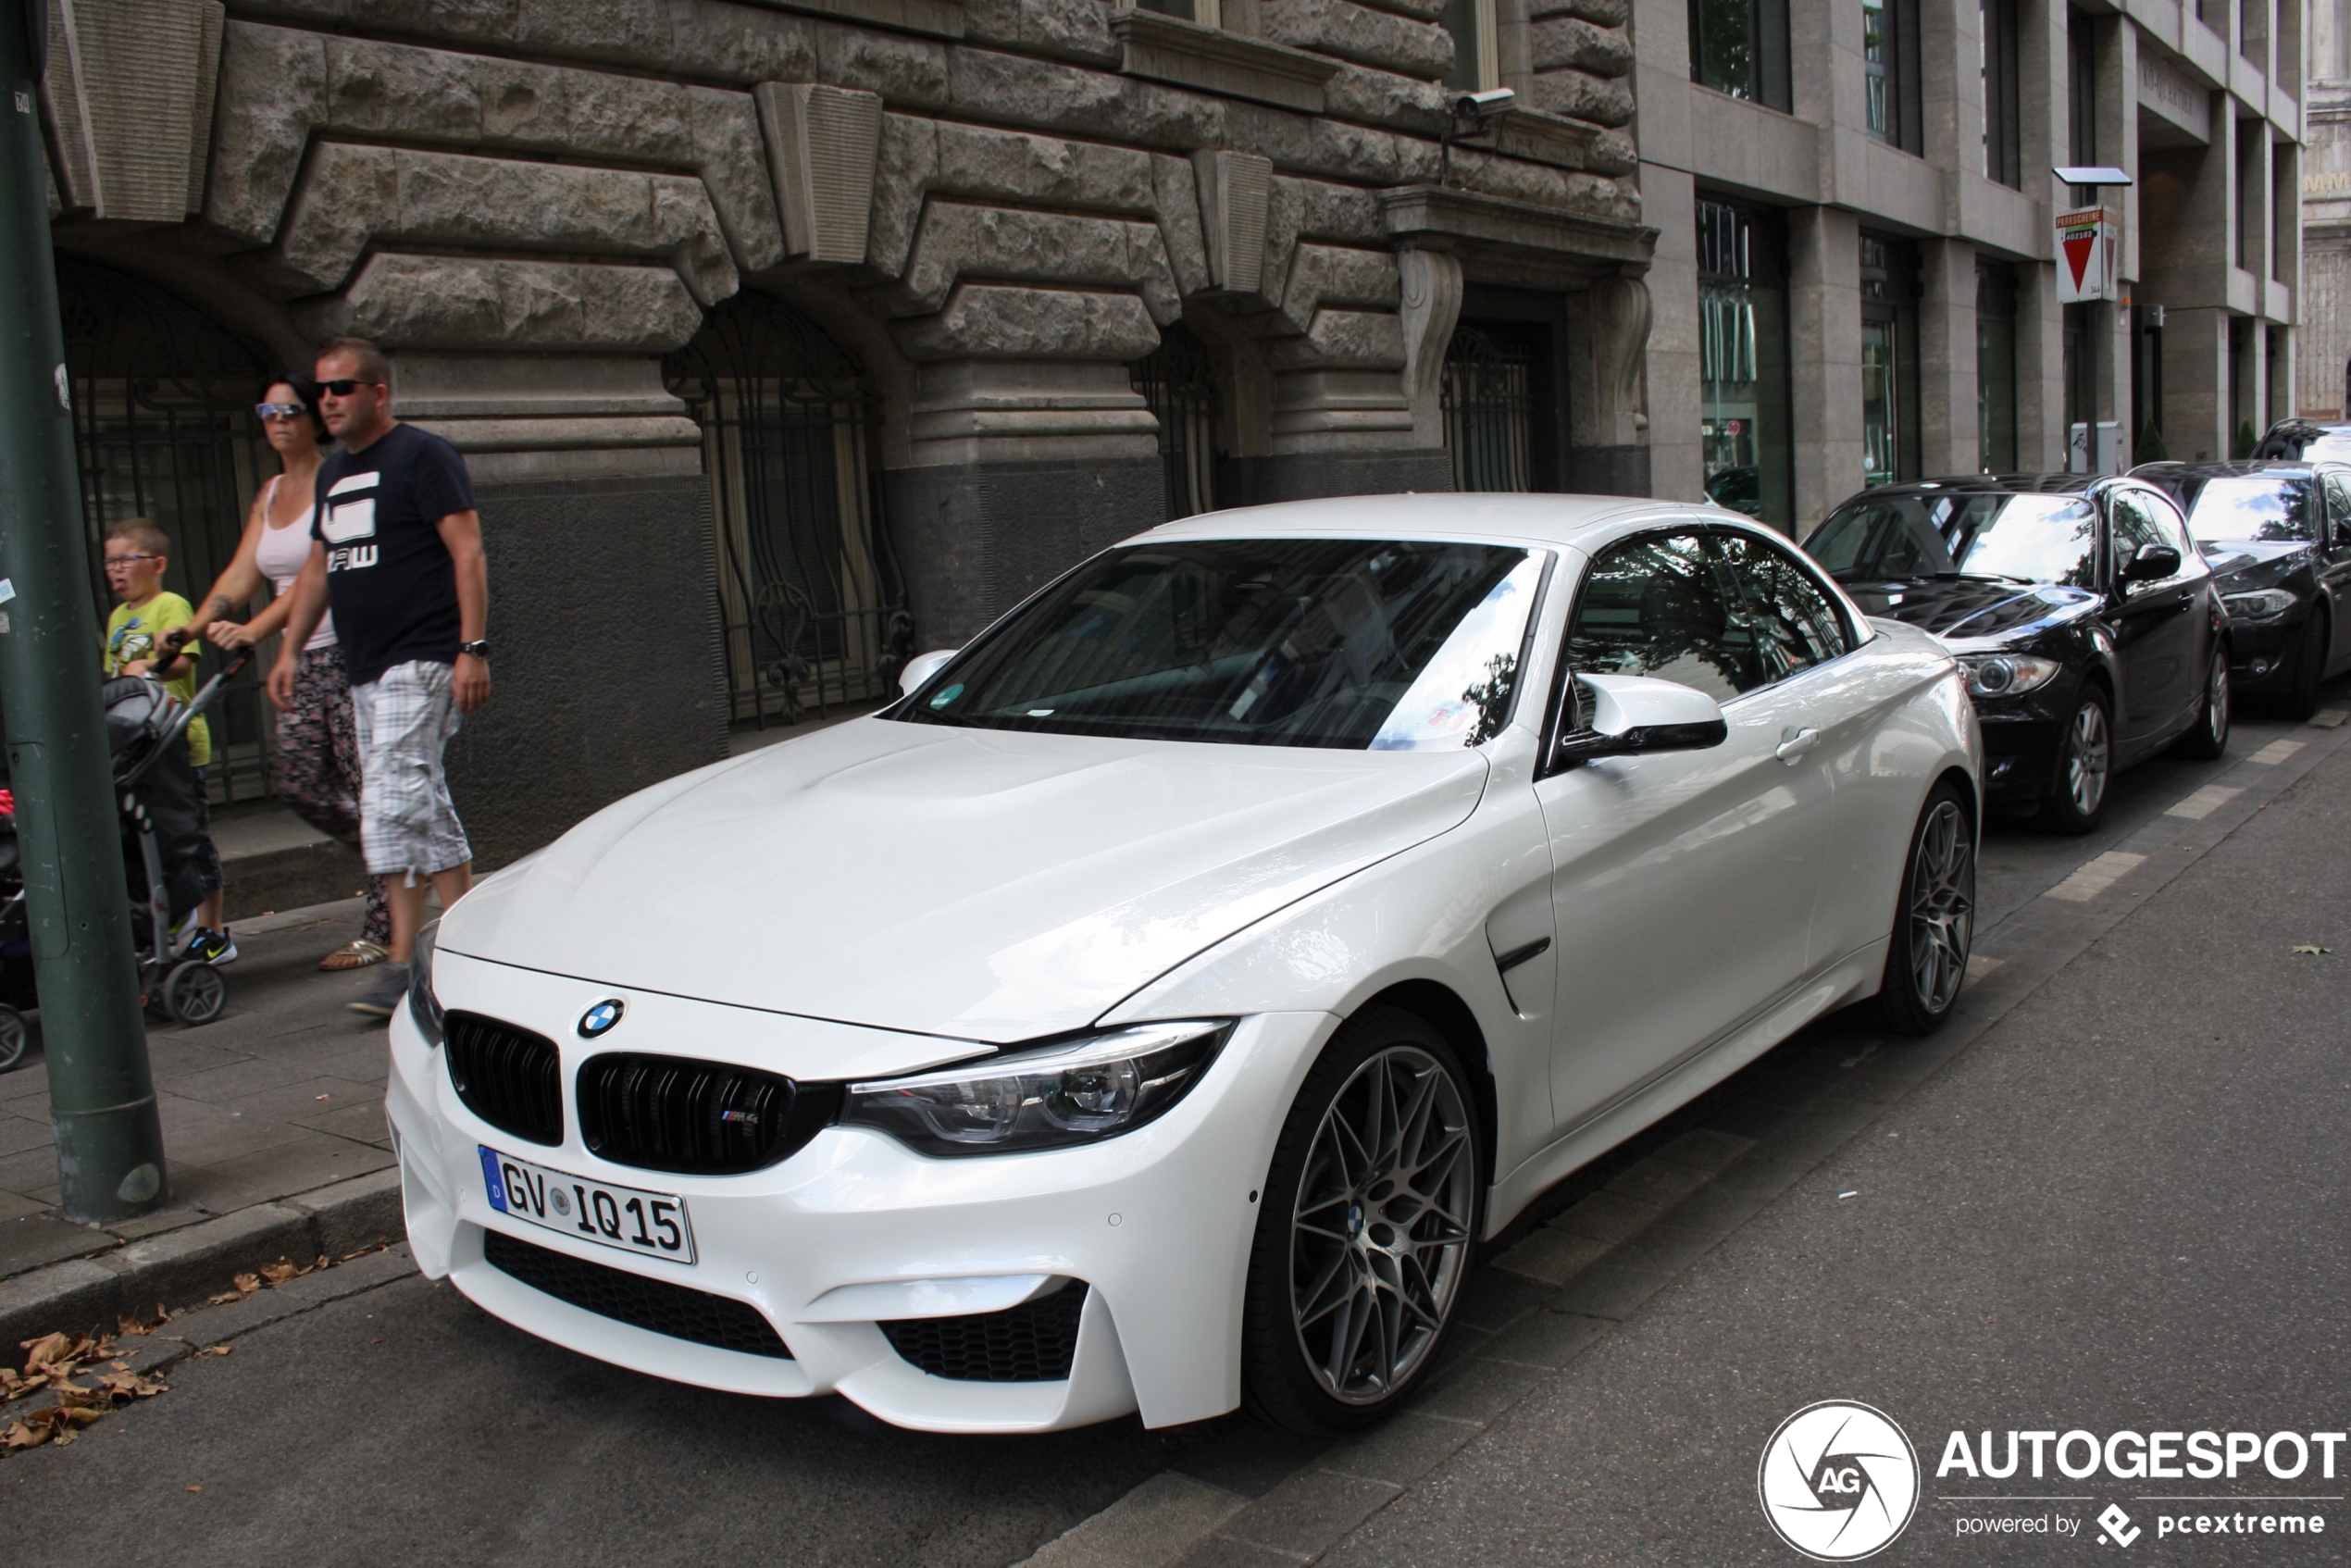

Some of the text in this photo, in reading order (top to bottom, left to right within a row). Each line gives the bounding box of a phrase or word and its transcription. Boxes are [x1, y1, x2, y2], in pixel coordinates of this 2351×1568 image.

[2057, 210, 2101, 227] PARKSCHEINE
[2066, 230, 2093, 241] 402102
[2090, 285, 2101, 294] 344
[492, 1184, 501, 1199] D
[503, 1162, 545, 1219] GV
